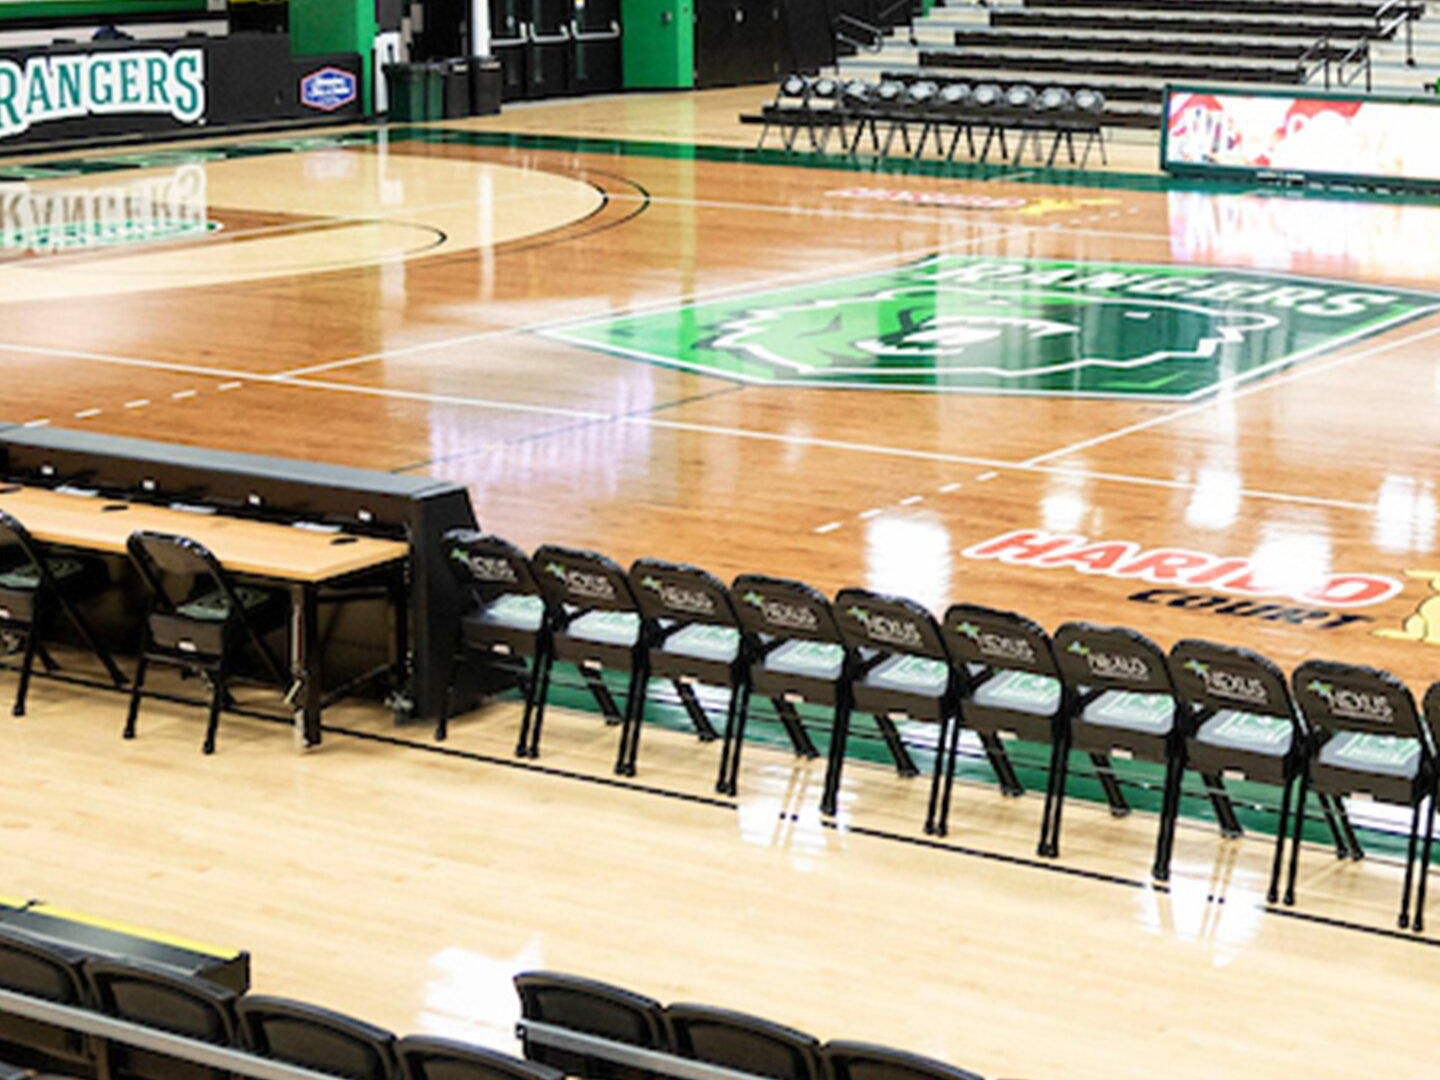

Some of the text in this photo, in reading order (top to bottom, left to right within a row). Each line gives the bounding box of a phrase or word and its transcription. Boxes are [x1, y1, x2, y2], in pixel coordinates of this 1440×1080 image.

[0, 52, 201, 130] RANGERS
[936, 262, 1403, 317] RANGERS
[970, 531, 1397, 605] HARIO
